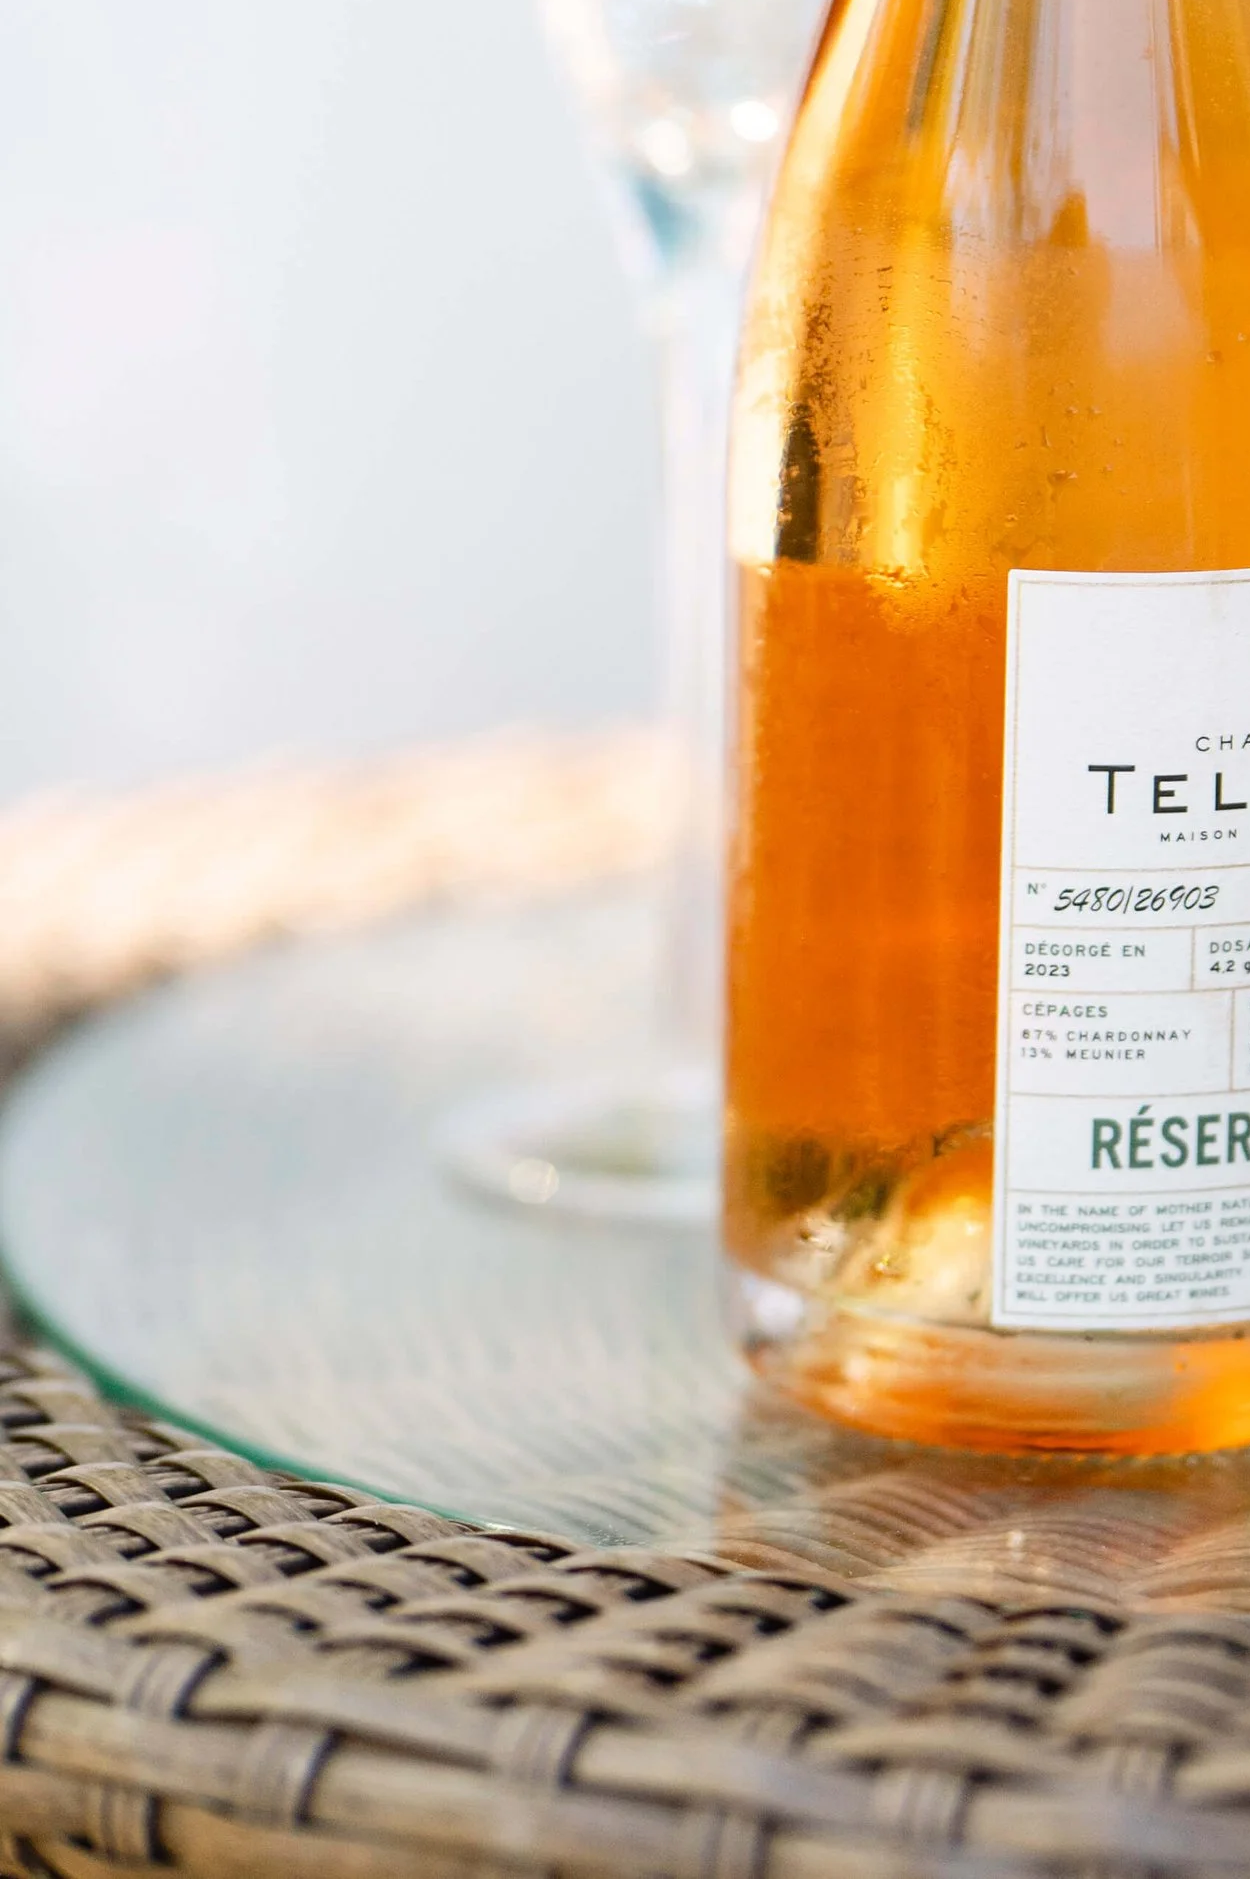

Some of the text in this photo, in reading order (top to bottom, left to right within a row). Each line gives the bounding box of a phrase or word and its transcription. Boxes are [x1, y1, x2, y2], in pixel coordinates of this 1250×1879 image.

[1160, 829, 1239, 843] MAISON
[1024, 940, 1147, 958] DÉGORGÉ EN
[1024, 963, 1071, 978] 2023
[1022, 1001, 1109, 1019] CÉPAGES
[1066, 1029, 1192, 1043] CHARDONNAY
[1020, 1047, 1147, 1061] 13% MEUNIER
[1016, 1203, 1032, 1215] IN
[1040, 1204, 1069, 1216] THE
[1078, 1205, 1120, 1217] NAME
[1128, 1204, 1149, 1217] OF
[1155, 1201, 1214, 1215] MOTHER
[1161, 1220, 1186, 1234] LET
[1193, 1218, 1212, 1231] US
[1016, 1237, 1101, 1252] VINEYARDS
[1109, 1238, 1124, 1251] IN
[1131, 1237, 1180, 1252] ORDER
[1188, 1235, 1206, 1249] TO
[1016, 1254, 1037, 1267] US
[1046, 1255, 1086, 1269] CARE
[1095, 1256, 1126, 1269] FOR
[1134, 1255, 1166, 1269] OUR
[1114, 1273, 1147, 1286] AND
[1054, 1290, 1102, 1303] OFFER
[1109, 1290, 1128, 1303] US
[1136, 1289, 1182, 1303] GREAT
